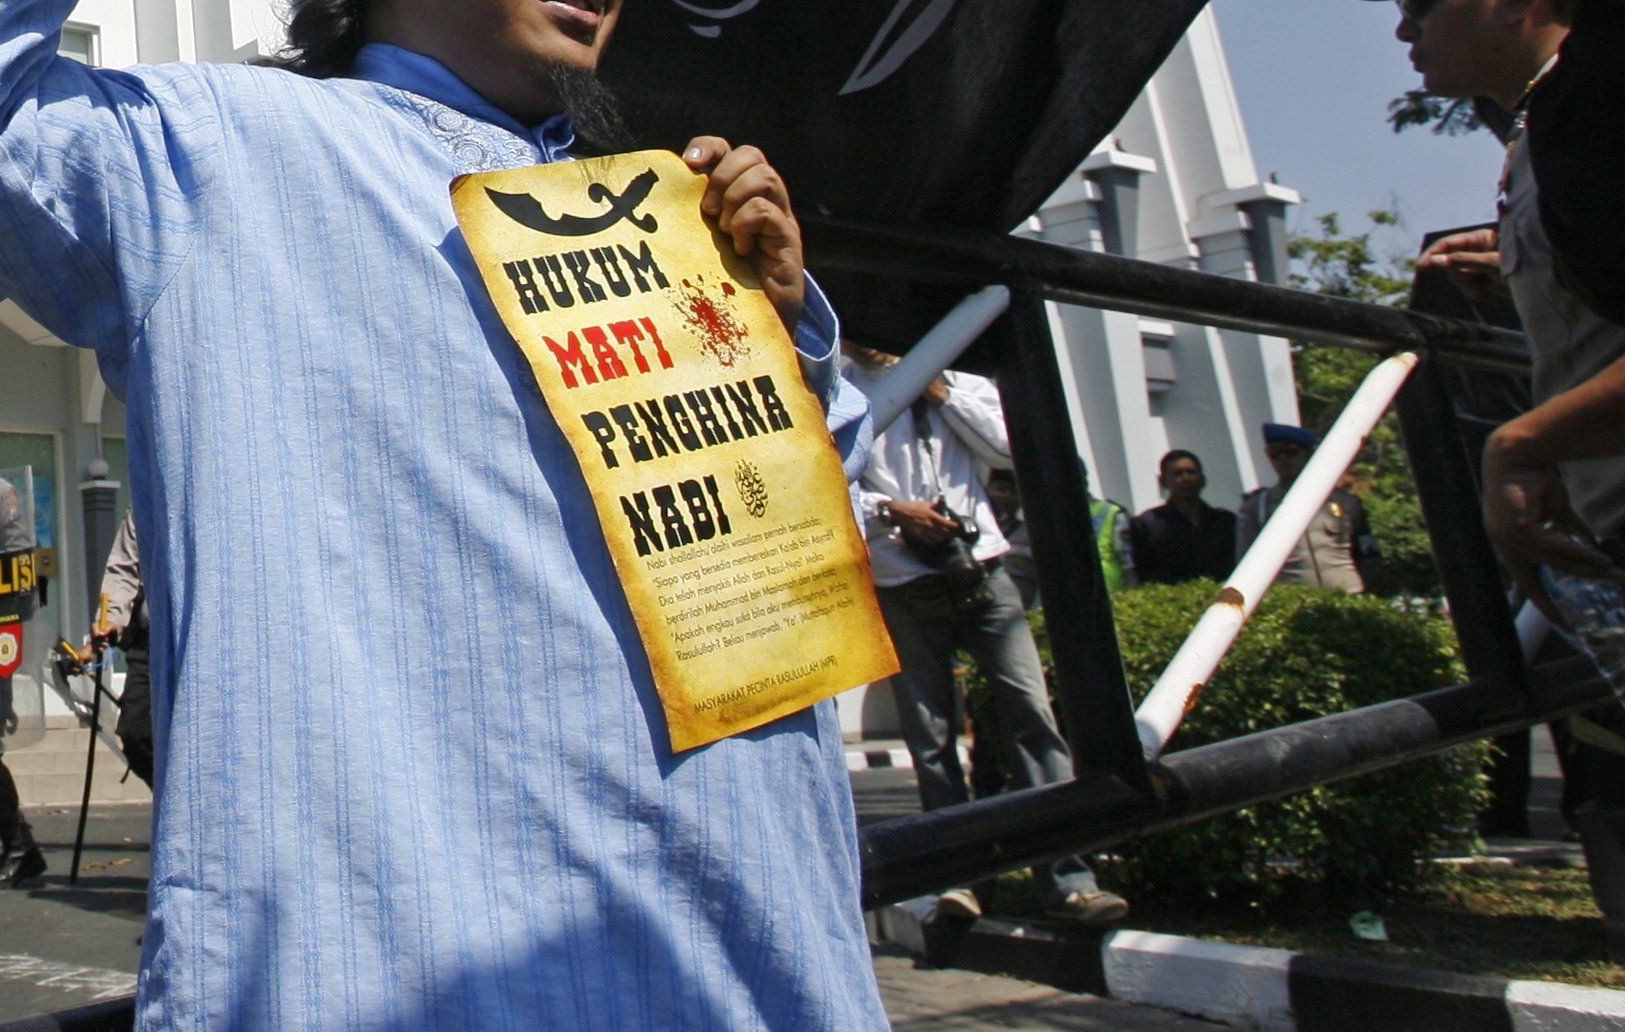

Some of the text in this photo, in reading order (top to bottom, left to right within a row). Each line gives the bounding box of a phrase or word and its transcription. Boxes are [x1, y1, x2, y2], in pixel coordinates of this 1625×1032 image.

[503, 240, 671, 315] HUKUM
[542, 316, 674, 389] MATI
[581, 374, 794, 469] PENGHINA
[619, 474, 731, 557] NABI
[646, 558, 667, 571] Nabi
[763, 524, 788, 541] pernah
[679, 570, 701, 585] yang
[701, 561, 731, 576] bersedia
[732, 547, 779, 567] membereskan
[799, 536, 811, 548] bin
[658, 594, 674, 607] Dia
[676, 588, 696, 602] telah
[697, 579, 733, 597] menyakiti
[733, 571, 751, 586] Allah
[752, 568, 766, 581] dan
[805, 552, 825, 566] Maka
[665, 607, 703, 625] berdirilah
[705, 594, 749, 613] Muhammad
[749, 588, 762, 601] bin
[762, 579, 798, 597] Maslamah
[798, 573, 811, 585] dan
[706, 618, 735, 635] engkau
[735, 611, 751, 625] suka
[751, 607, 766, 620] bila
[766, 603, 781, 615] aku
[675, 639, 721, 661] Rasulullah?
[694, 686, 746, 713] MASYARAKAT
[746, 677, 776, 696] PECINTA
[776, 660, 819, 685] RASULULLAH
